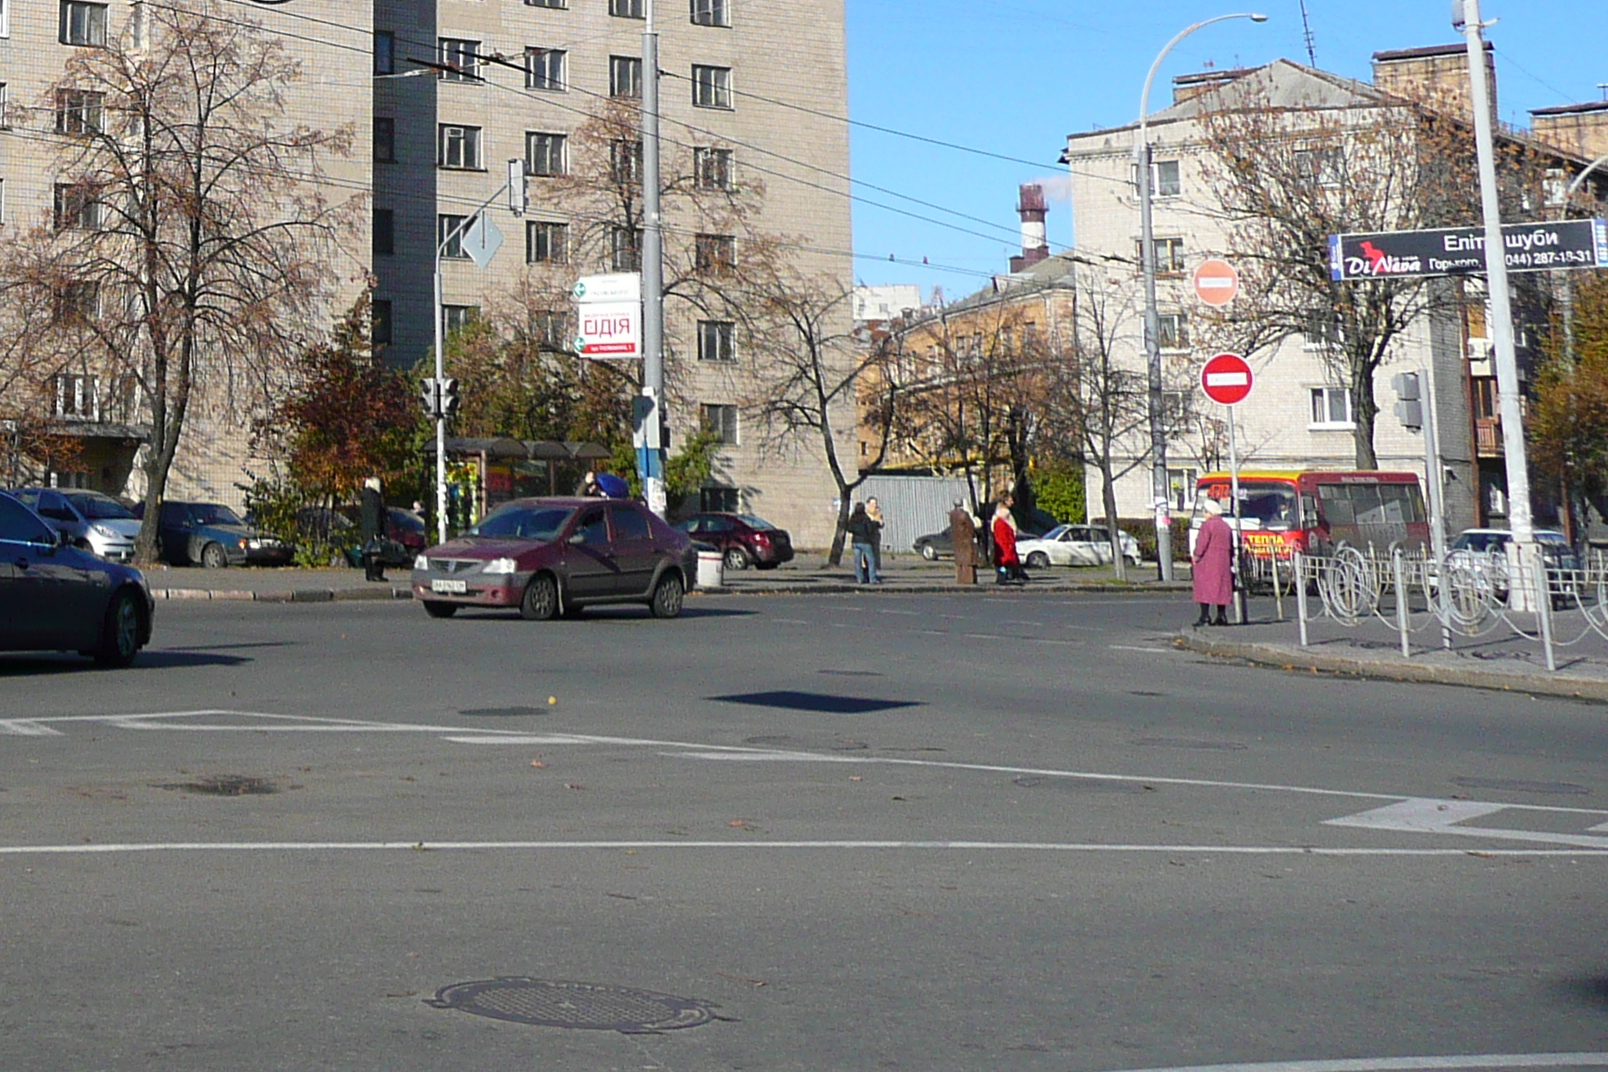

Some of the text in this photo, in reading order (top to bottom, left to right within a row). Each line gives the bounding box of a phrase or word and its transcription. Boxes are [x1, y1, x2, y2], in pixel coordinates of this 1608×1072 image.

[1443, 229, 1558, 251] Еліт шуби
[1505, 253, 1531, 267] 044)
